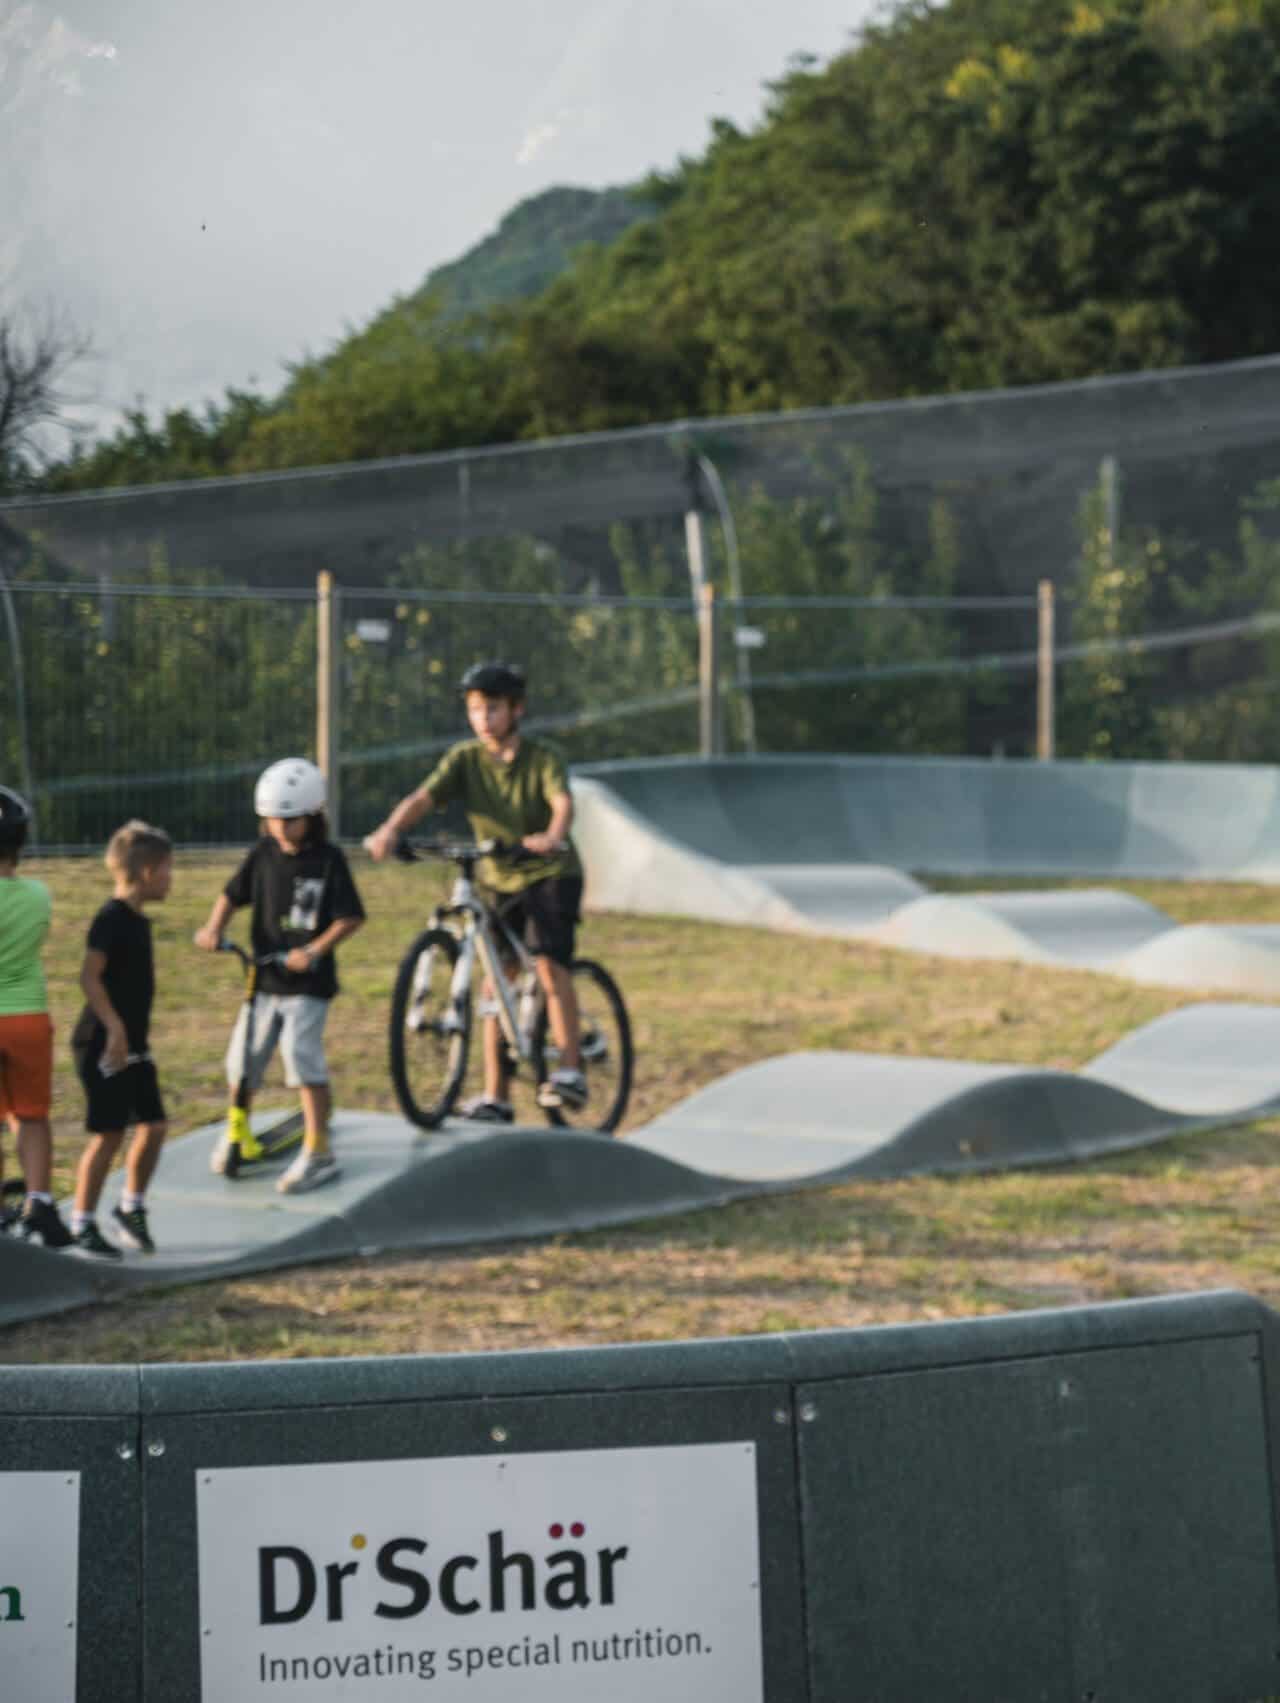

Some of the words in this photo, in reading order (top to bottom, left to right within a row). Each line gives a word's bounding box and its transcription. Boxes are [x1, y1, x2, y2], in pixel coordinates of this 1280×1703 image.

[259, 1644, 436, 1683] Innovating
[447, 1633, 561, 1677] special
[571, 1626, 713, 1663] nutrition.
